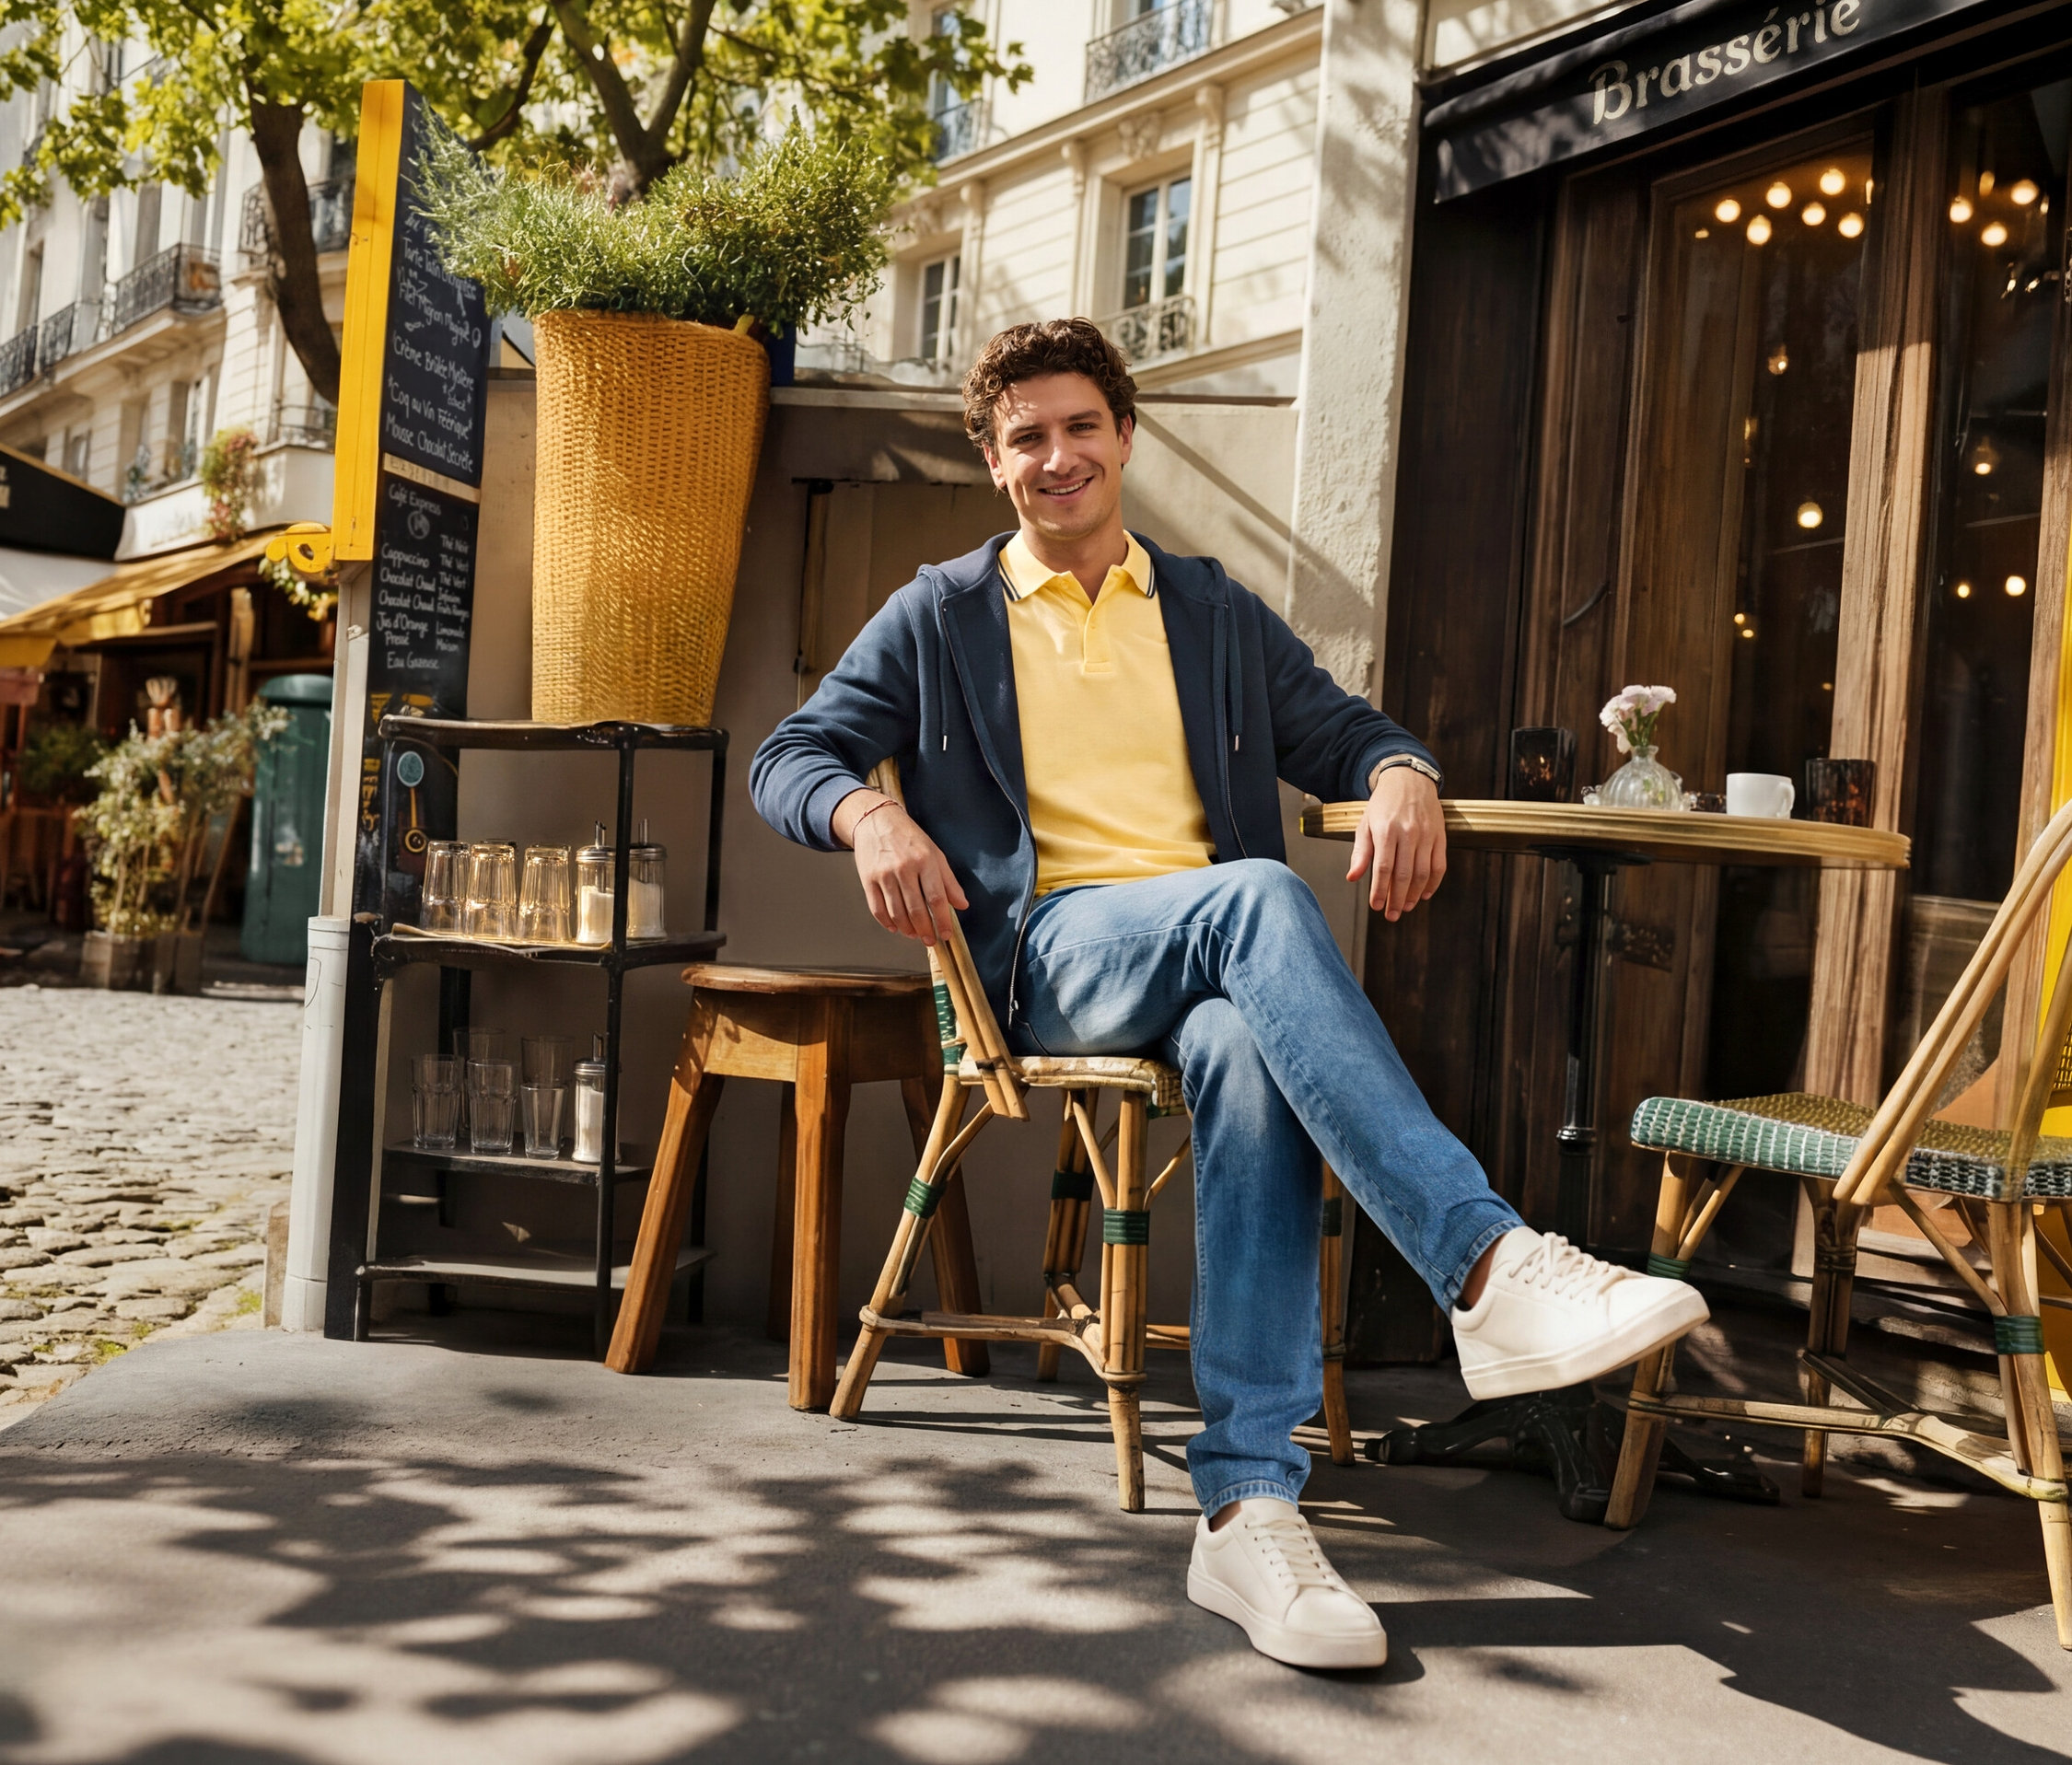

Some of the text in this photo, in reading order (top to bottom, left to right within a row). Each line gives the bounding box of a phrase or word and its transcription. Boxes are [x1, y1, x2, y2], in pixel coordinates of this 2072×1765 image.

[1589, 0, 1861, 125] Brassérie
[386, 412, 414, 447] Mousse
[417, 430, 448, 459] Chocolat
[381, 542, 430, 569] Cappuccino
[376, 610, 391, 632] Jus
[387, 650, 404, 669] Eau
